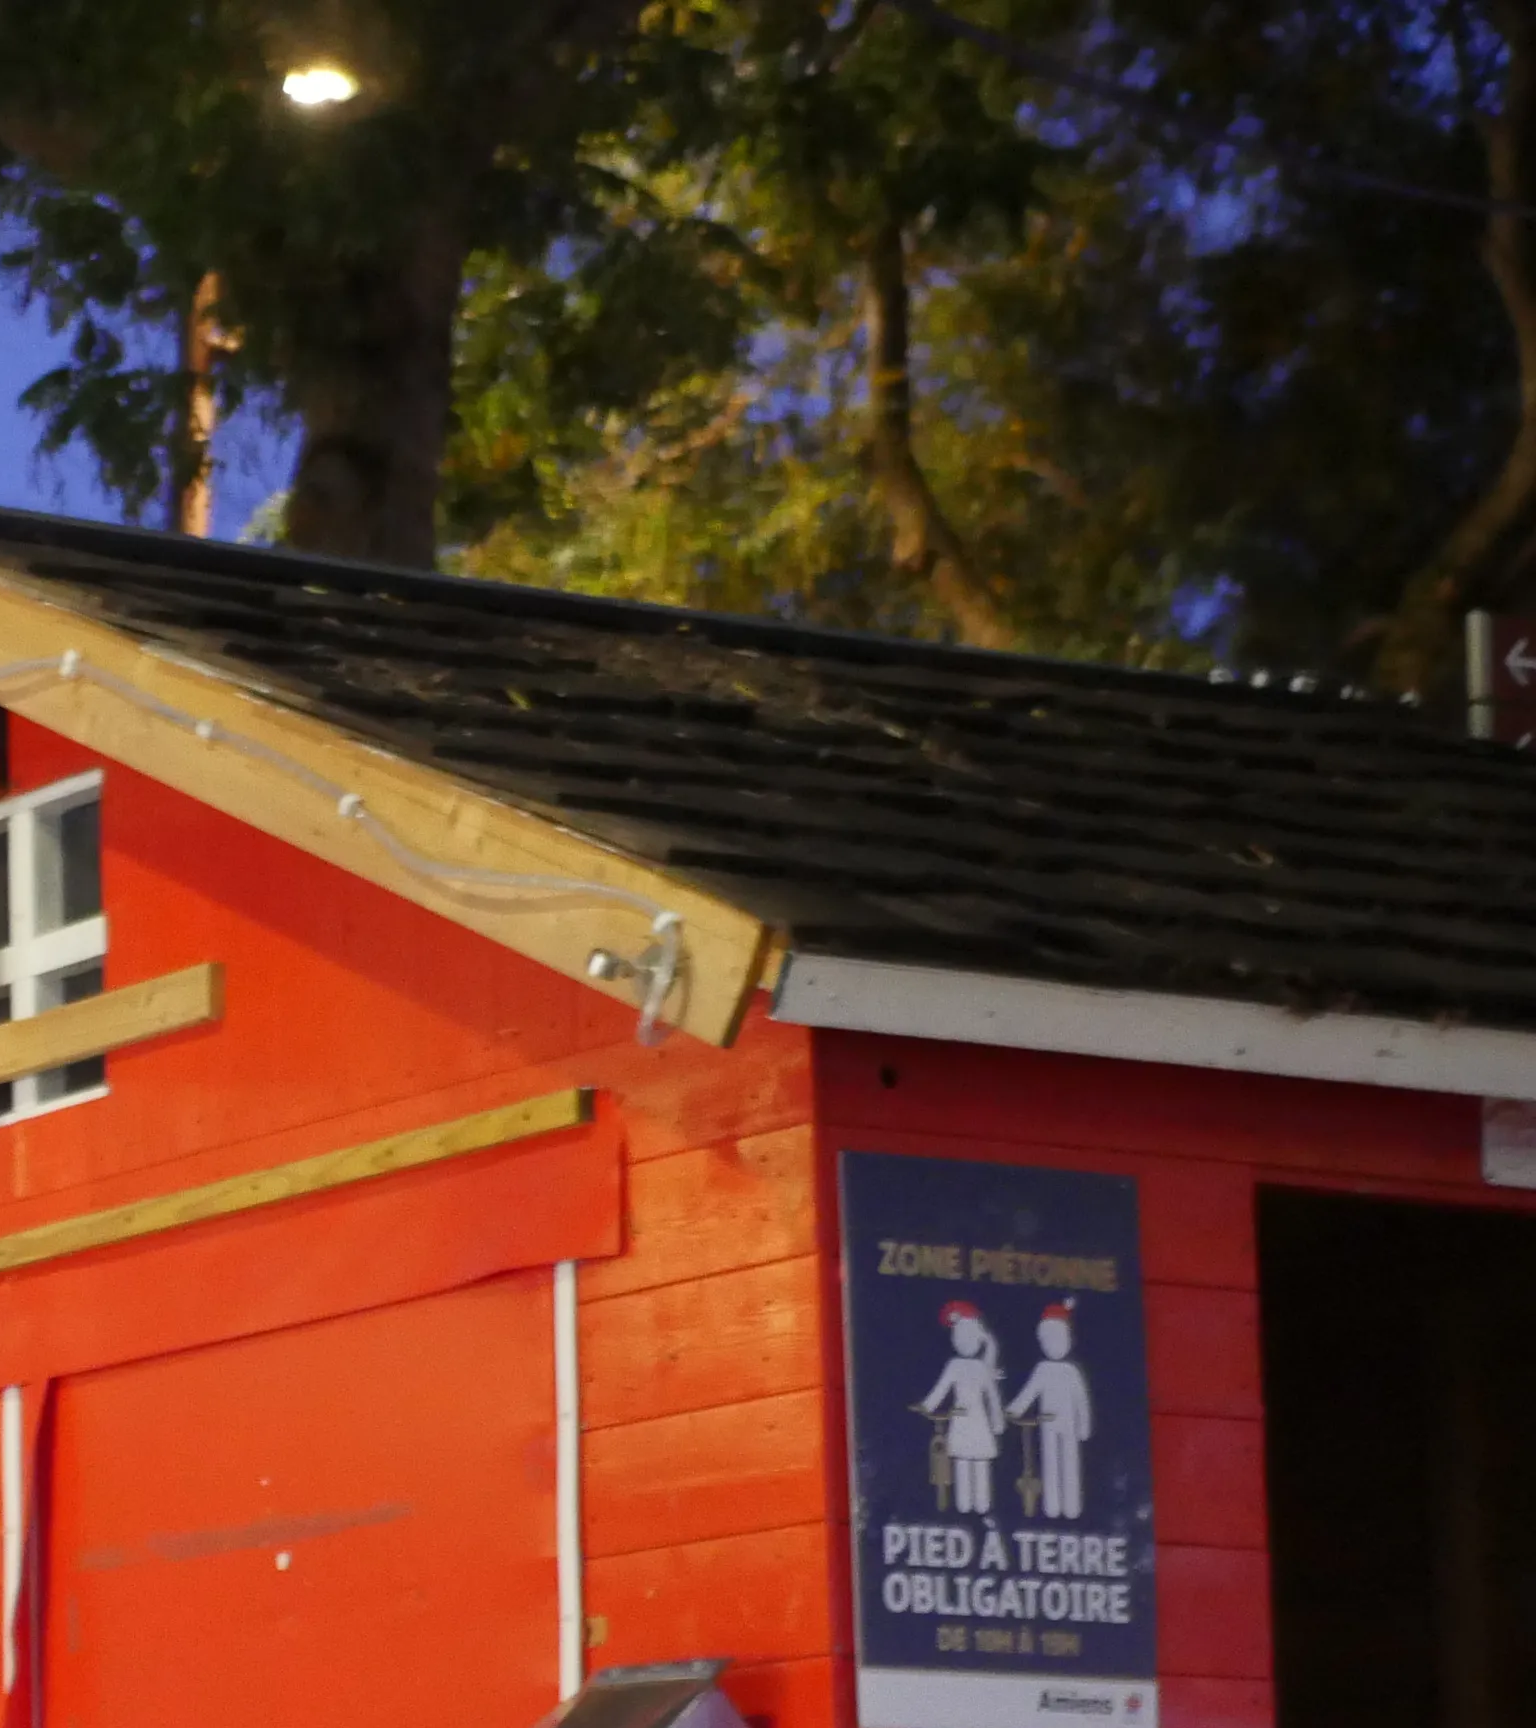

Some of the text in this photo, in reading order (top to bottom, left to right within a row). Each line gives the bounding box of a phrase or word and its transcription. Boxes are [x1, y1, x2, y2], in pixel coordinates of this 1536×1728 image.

[877, 1239, 963, 1280] ZONE
[882, 1516, 1129, 1577] PIED À TERRE
[882, 1572, 1131, 1625] OBLIGATOIRE
